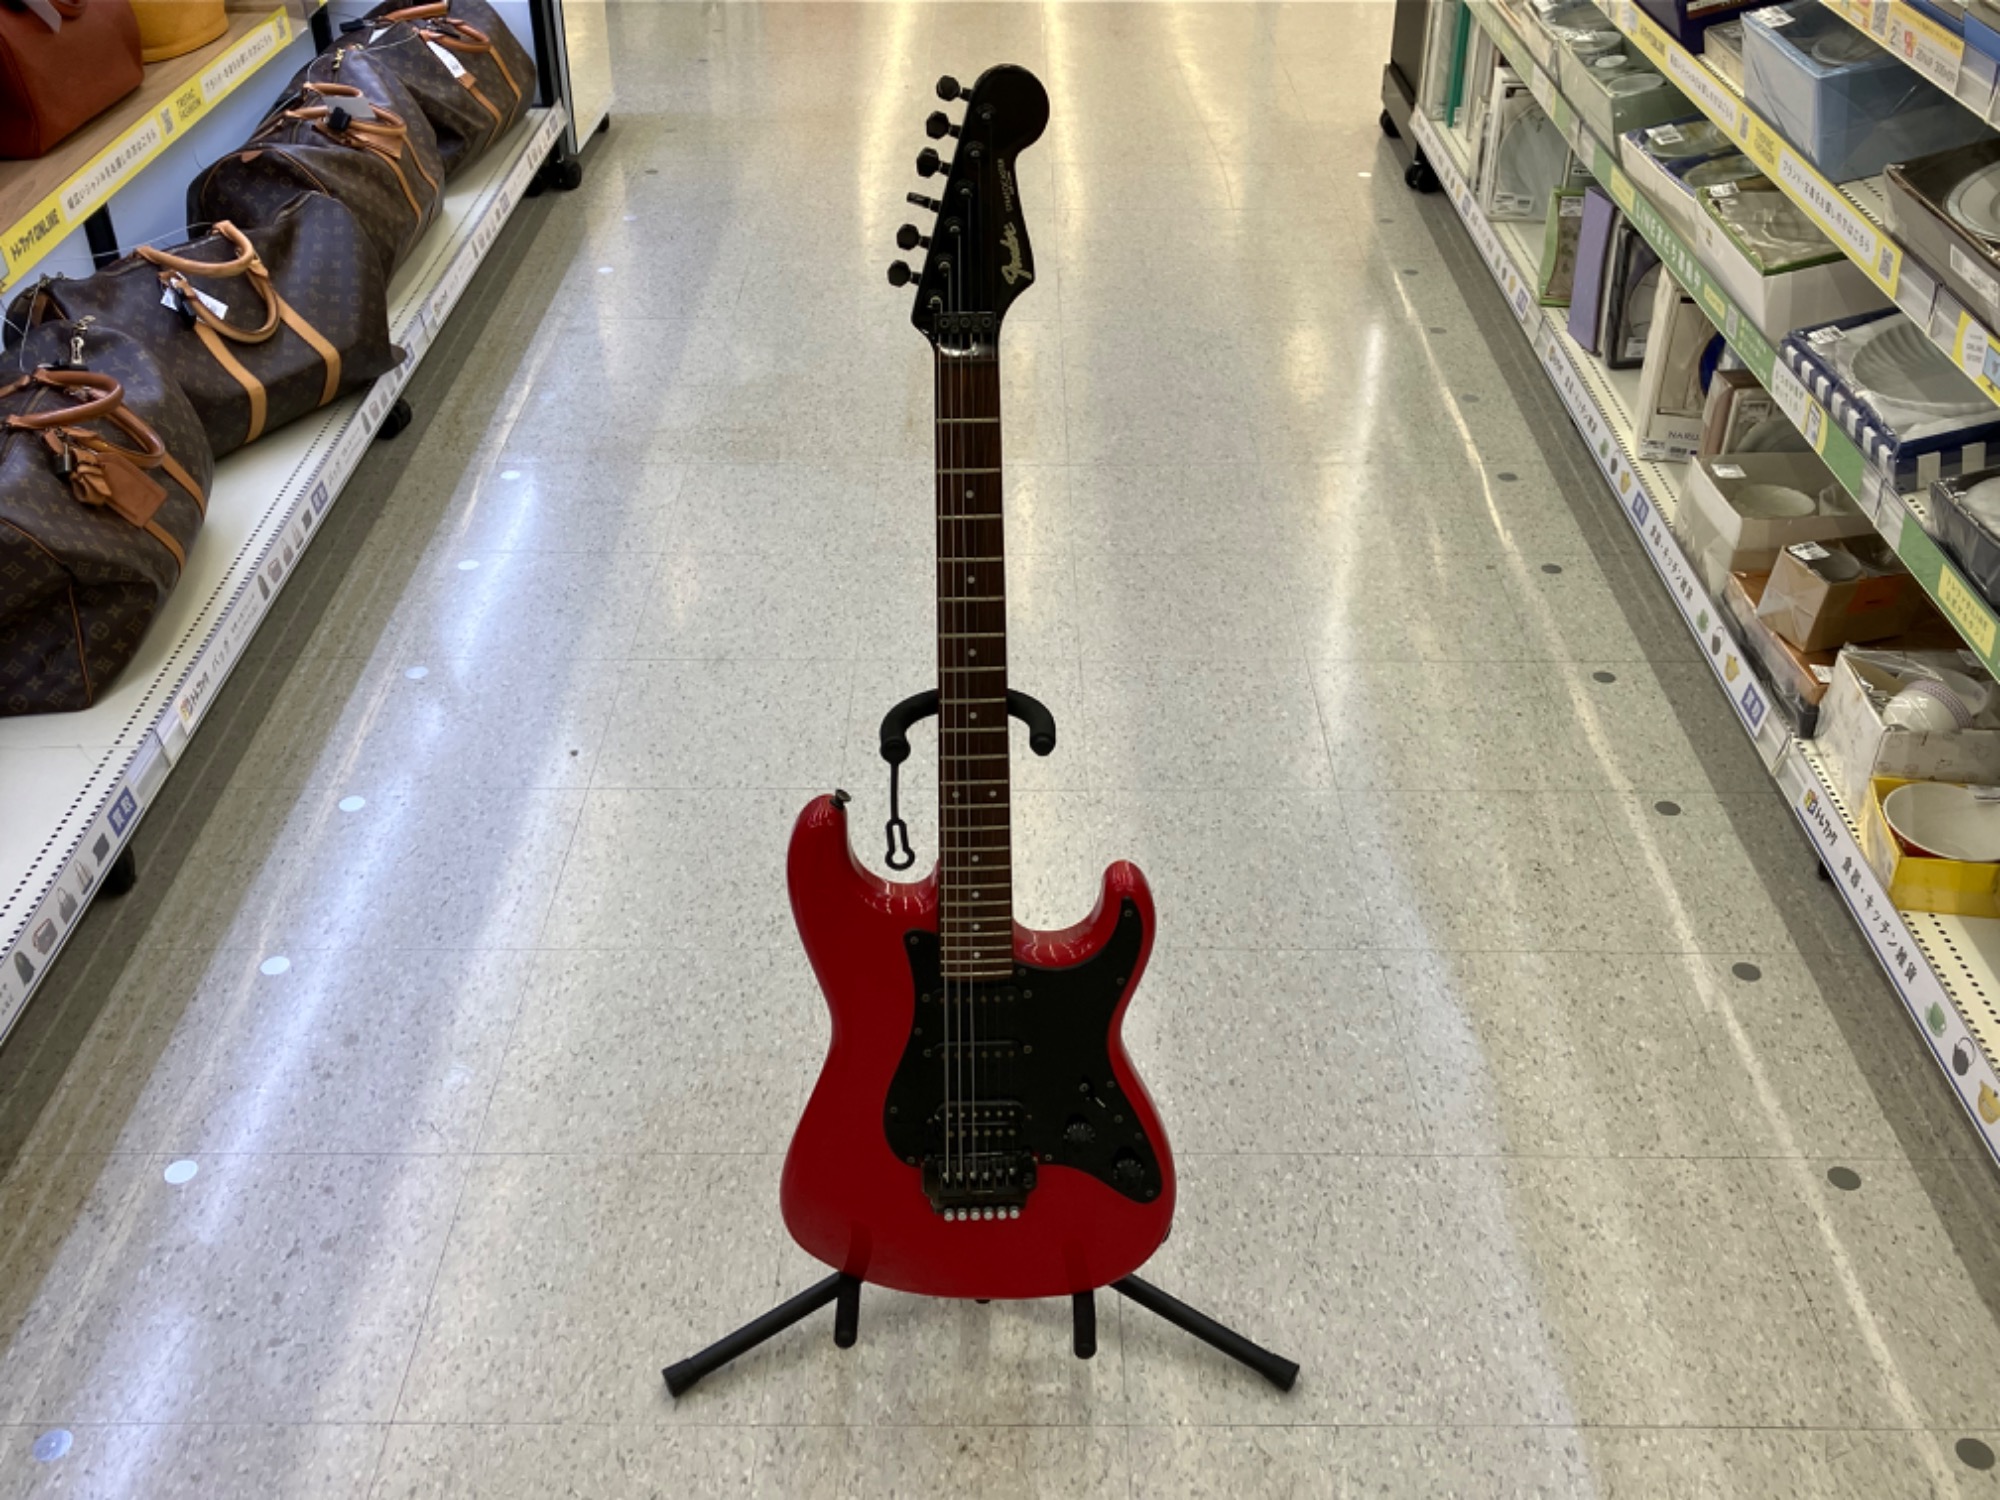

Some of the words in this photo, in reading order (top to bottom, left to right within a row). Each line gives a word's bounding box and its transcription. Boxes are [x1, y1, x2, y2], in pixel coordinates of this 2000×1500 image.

[999, 221, 1033, 285] Fender
[1815, 804, 1839, 846] トレファク
[1840, 855, 1919, 986] 食器・キッチン雑貨
